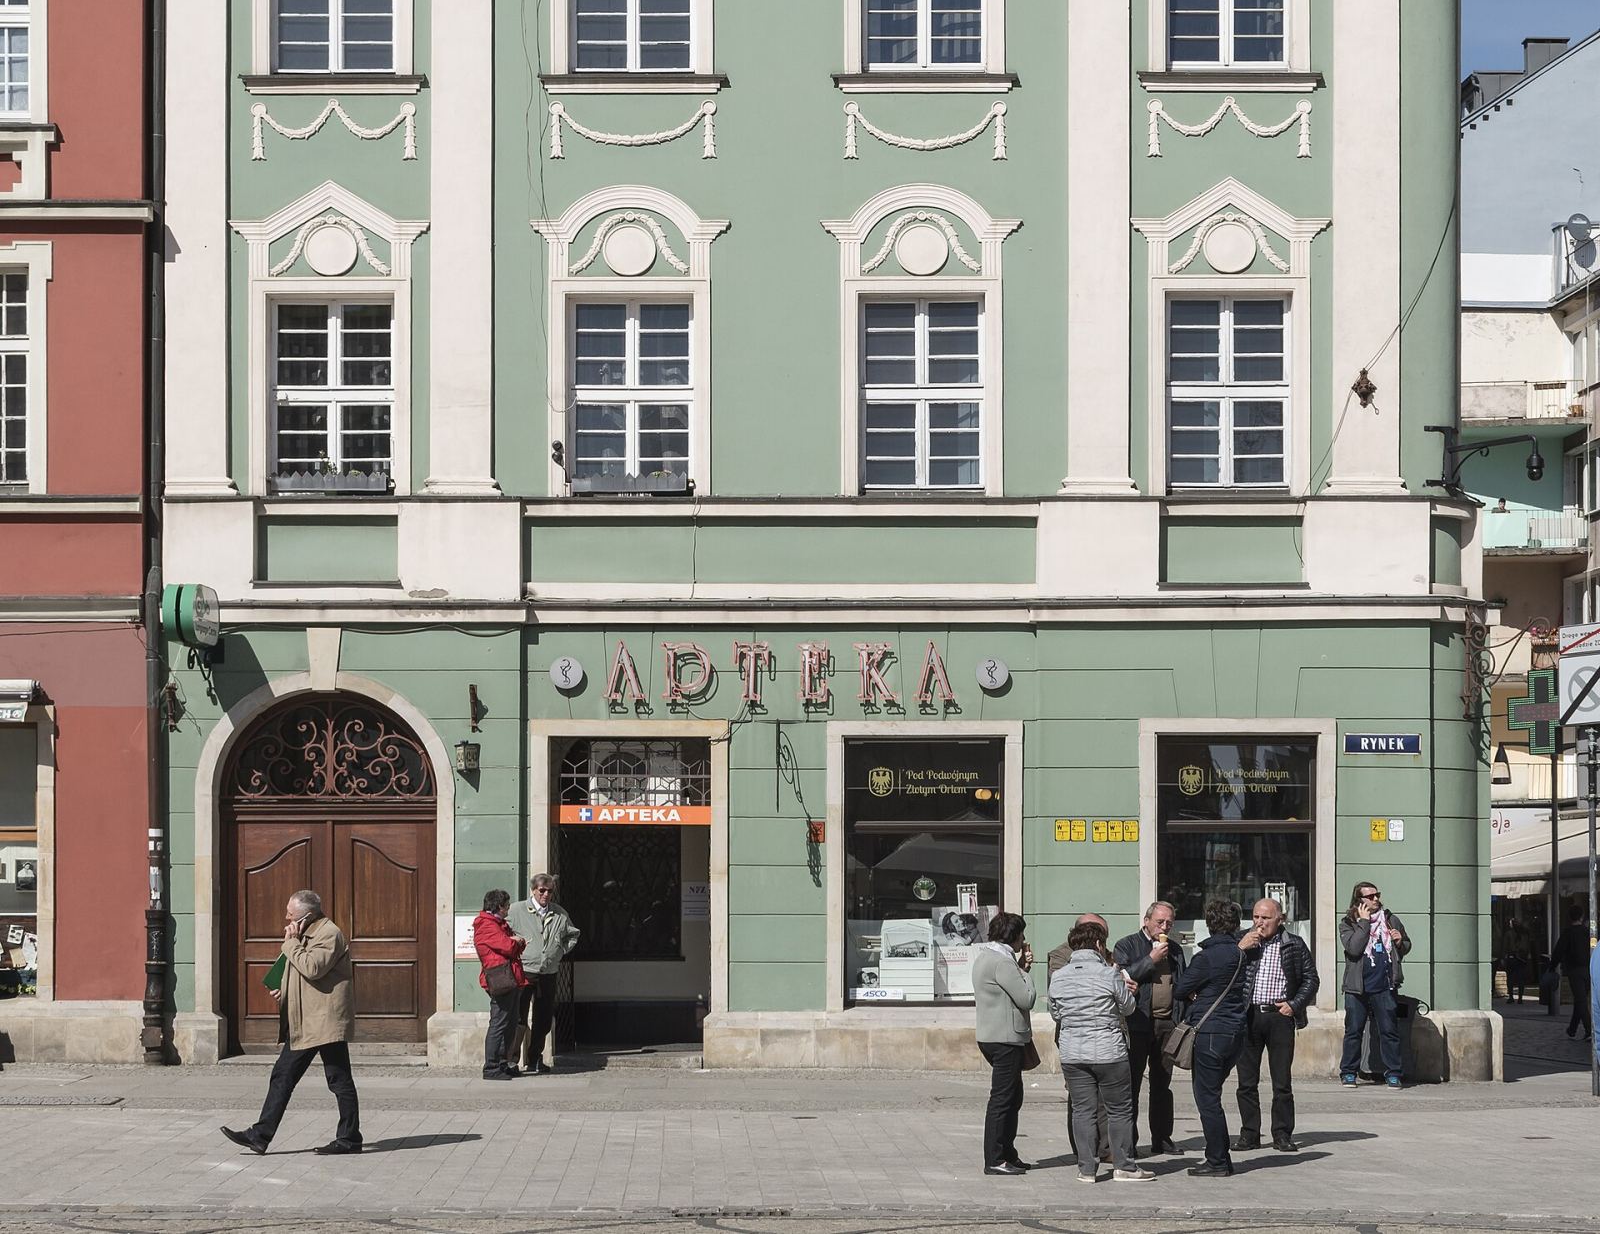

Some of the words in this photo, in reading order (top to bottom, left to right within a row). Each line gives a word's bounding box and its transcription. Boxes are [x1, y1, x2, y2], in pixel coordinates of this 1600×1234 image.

[603, 639, 954, 700] APTEKA
[1360, 737, 1405, 750] RYNEK
[906, 769, 925, 780] Pod
[926, 769, 979, 783] Podwójnym
[1216, 769, 1235, 779] Pod
[598, 808, 681, 822] APTEKA
[863, 990, 888, 998] ASCO
